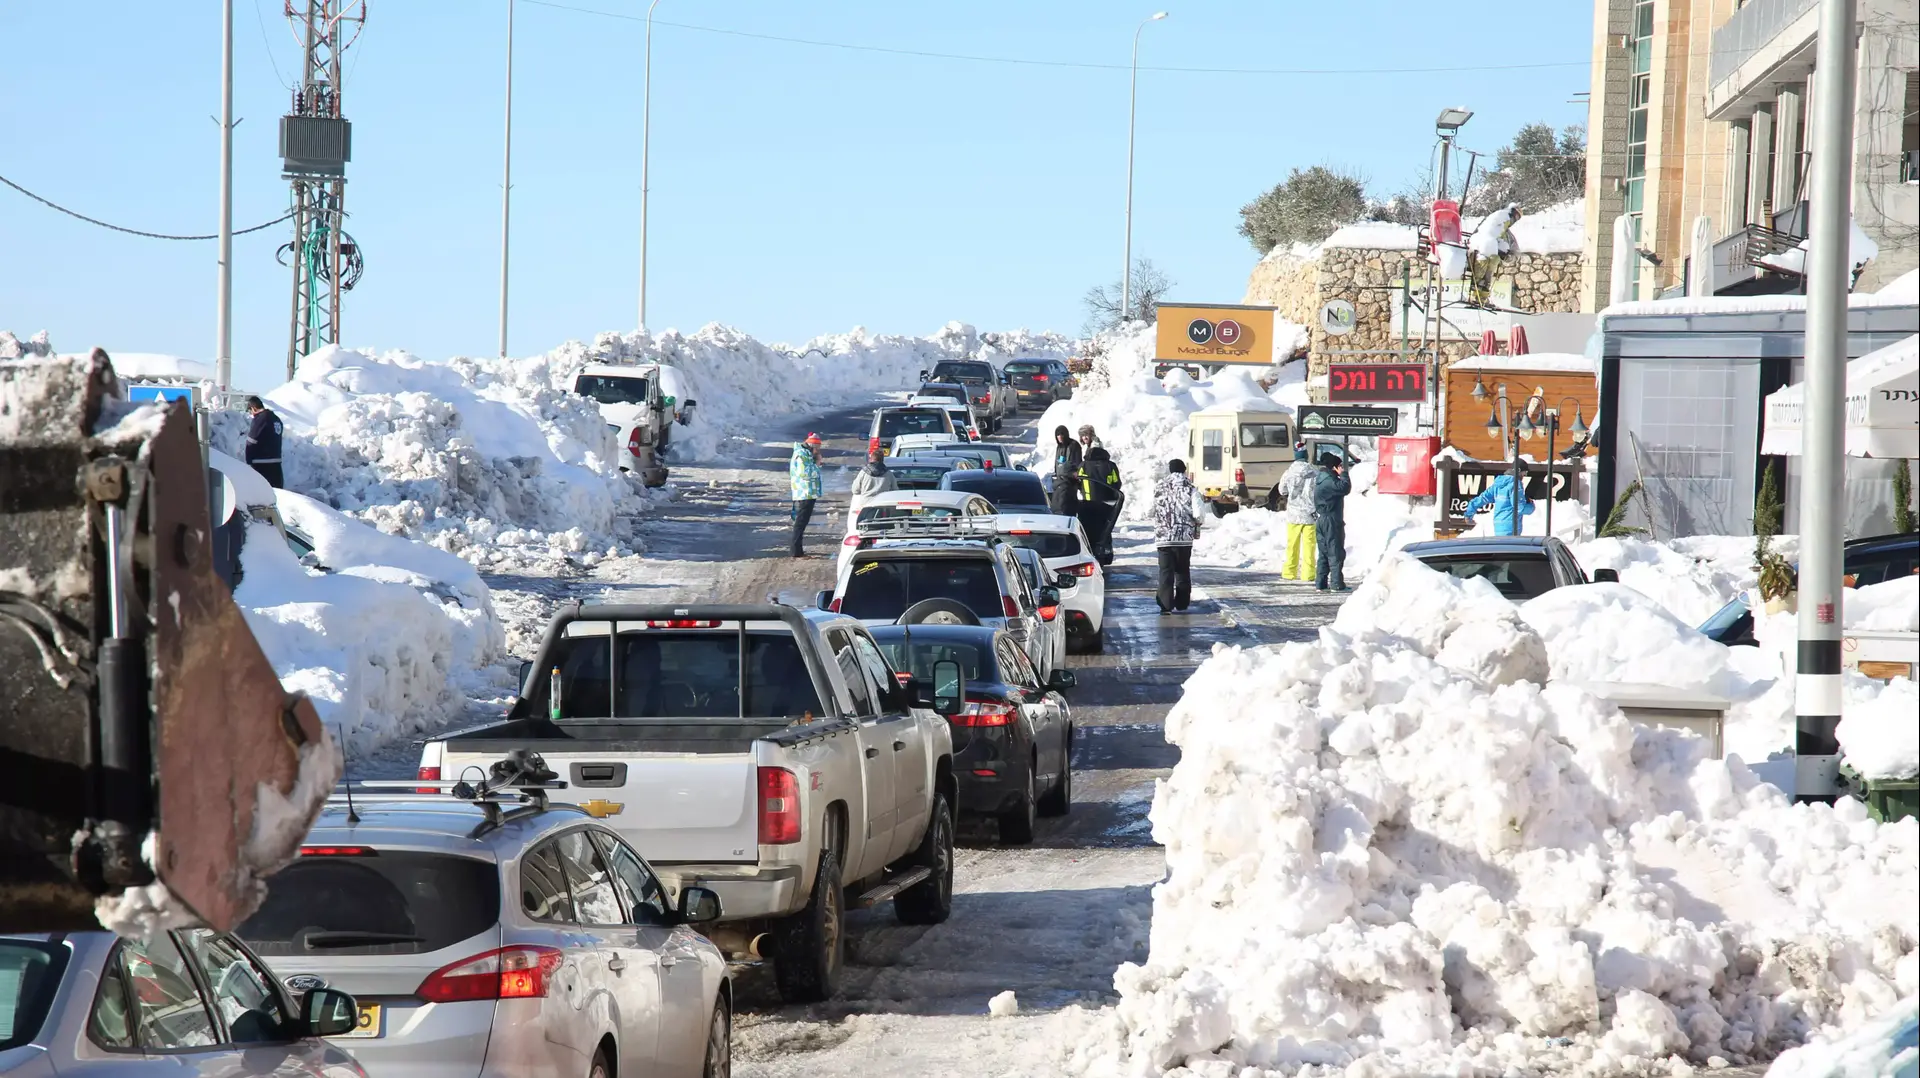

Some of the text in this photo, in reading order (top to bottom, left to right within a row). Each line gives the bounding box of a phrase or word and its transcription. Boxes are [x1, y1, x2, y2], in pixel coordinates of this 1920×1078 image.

[1194, 327, 1233, 336] M B
[1177, 346, 1250, 356] Majdal Burger
[1387, 370, 1424, 390] רה
[1329, 416, 1389, 426] RESTAURANT
[293, 979, 316, 989] Ford
